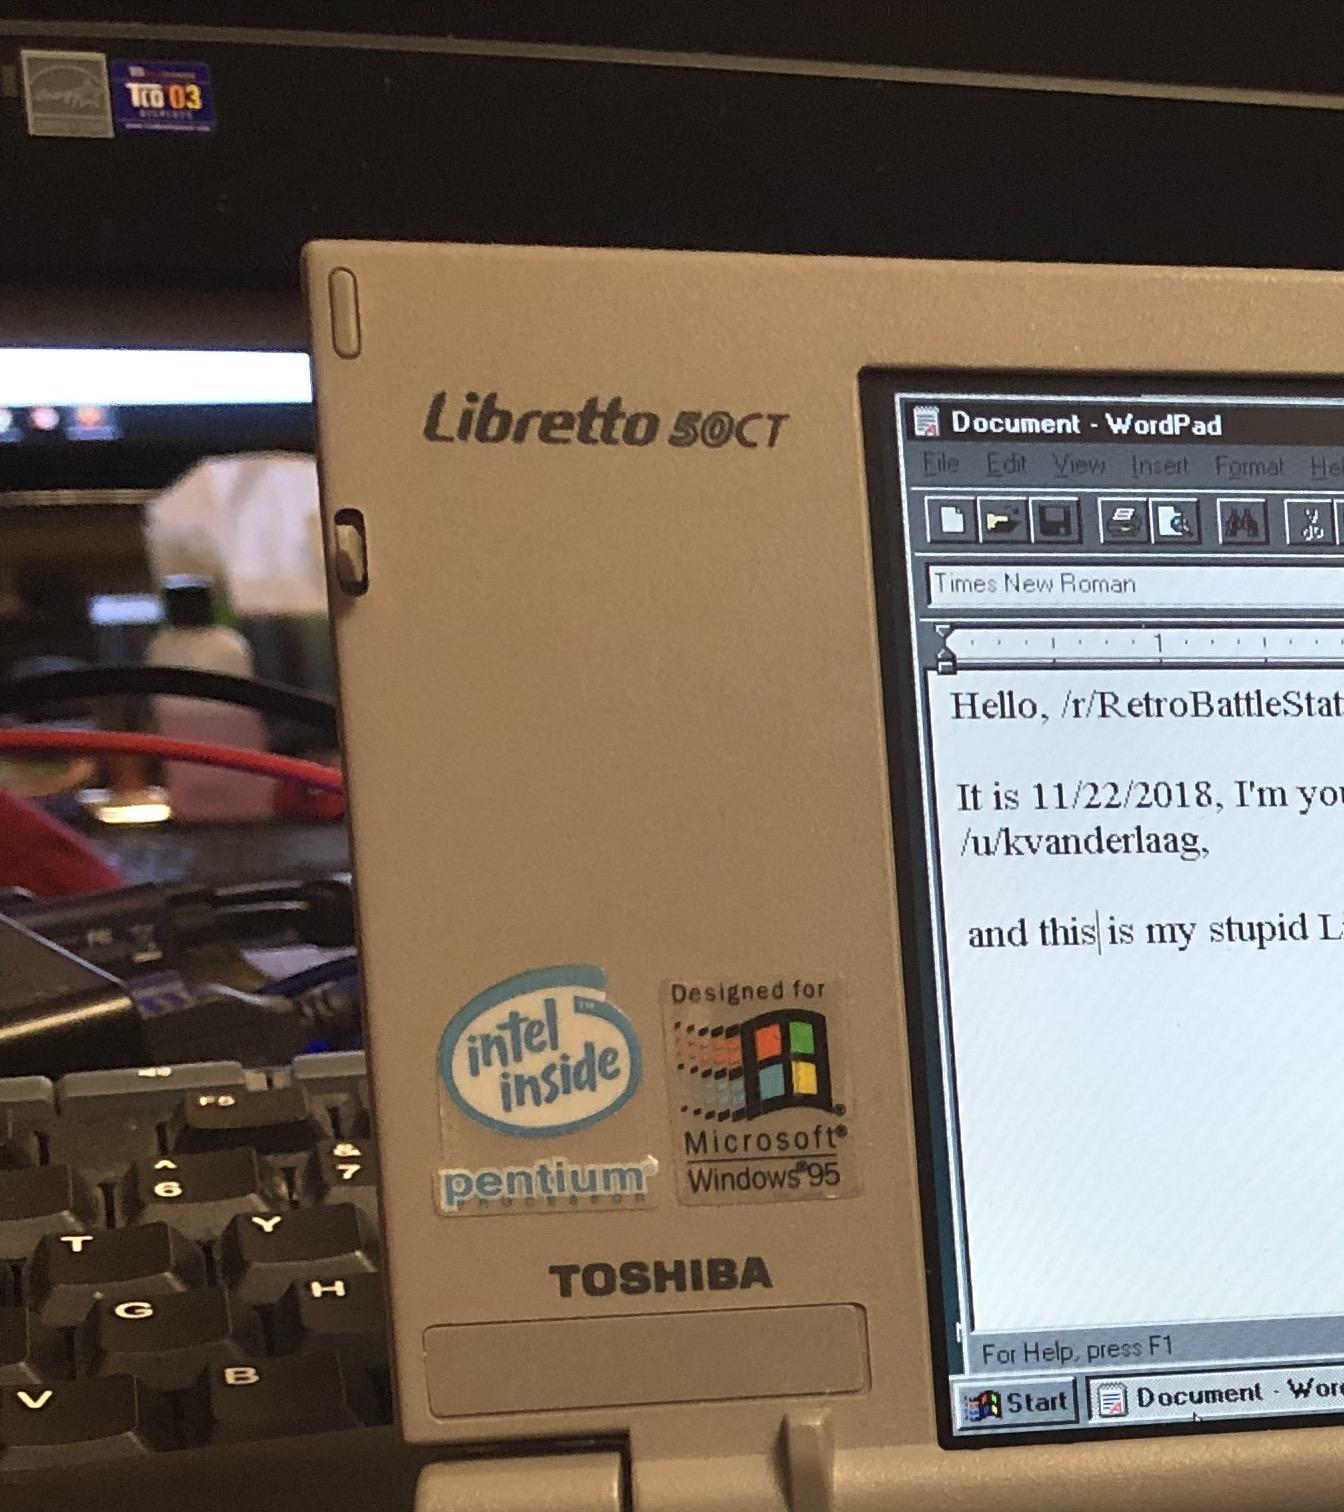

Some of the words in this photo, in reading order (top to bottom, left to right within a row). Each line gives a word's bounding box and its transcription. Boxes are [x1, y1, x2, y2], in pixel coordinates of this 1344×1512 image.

[168, 83, 203, 111] 03
[422, 390, 661, 447] Libretto
[667, 410, 791, 449] 50CT
[952, 411, 1081, 434] Document
[1105, 412, 1223, 437] WordPad
[922, 452, 960, 477] File
[987, 452, 1029, 478] Edit
[1053, 453, 1106, 479] View
[1132, 455, 1190, 479] Insert
[1215, 455, 1286, 481] Format
[934, 572, 998, 594] Times
[1003, 572, 1053, 594] New
[1060, 572, 1137, 594] Roman
[950, 690, 1049, 725] Hello,
[956, 782, 983, 812] It
[993, 781, 1020, 811] is
[1033, 779, 1224, 814] 11/22/2018,
[1234, 779, 1289, 808] I'm
[960, 825, 1210, 862] /u/kvanderlaag,
[967, 917, 1029, 948] and
[1039, 916, 1097, 946] this
[1108, 915, 1134, 945] is
[1146, 921, 1197, 952] my
[1209, 912, 1309, 951] stupid
[670, 980, 785, 1006] Designed
[791, 979, 825, 1001] for
[466, 997, 559, 1079] intel
[500, 1040, 624, 1114] inside
[443, 1160, 645, 1207] pentium
[251, 1214, 282, 1233] Y
[60, 1235, 94, 1253] T
[310, 1280, 346, 1298] H
[548, 1256, 774, 1298] TOSHIBA
[113, 1300, 154, 1320] G
[981, 1343, 1016, 1366] For
[1023, 1340, 1081, 1365] Help,
[1086, 1340, 1143, 1363] press
[1149, 1335, 1174, 1356] F1
[1006, 1389, 1069, 1415] Start
[1137, 1383, 1264, 1409] Document
